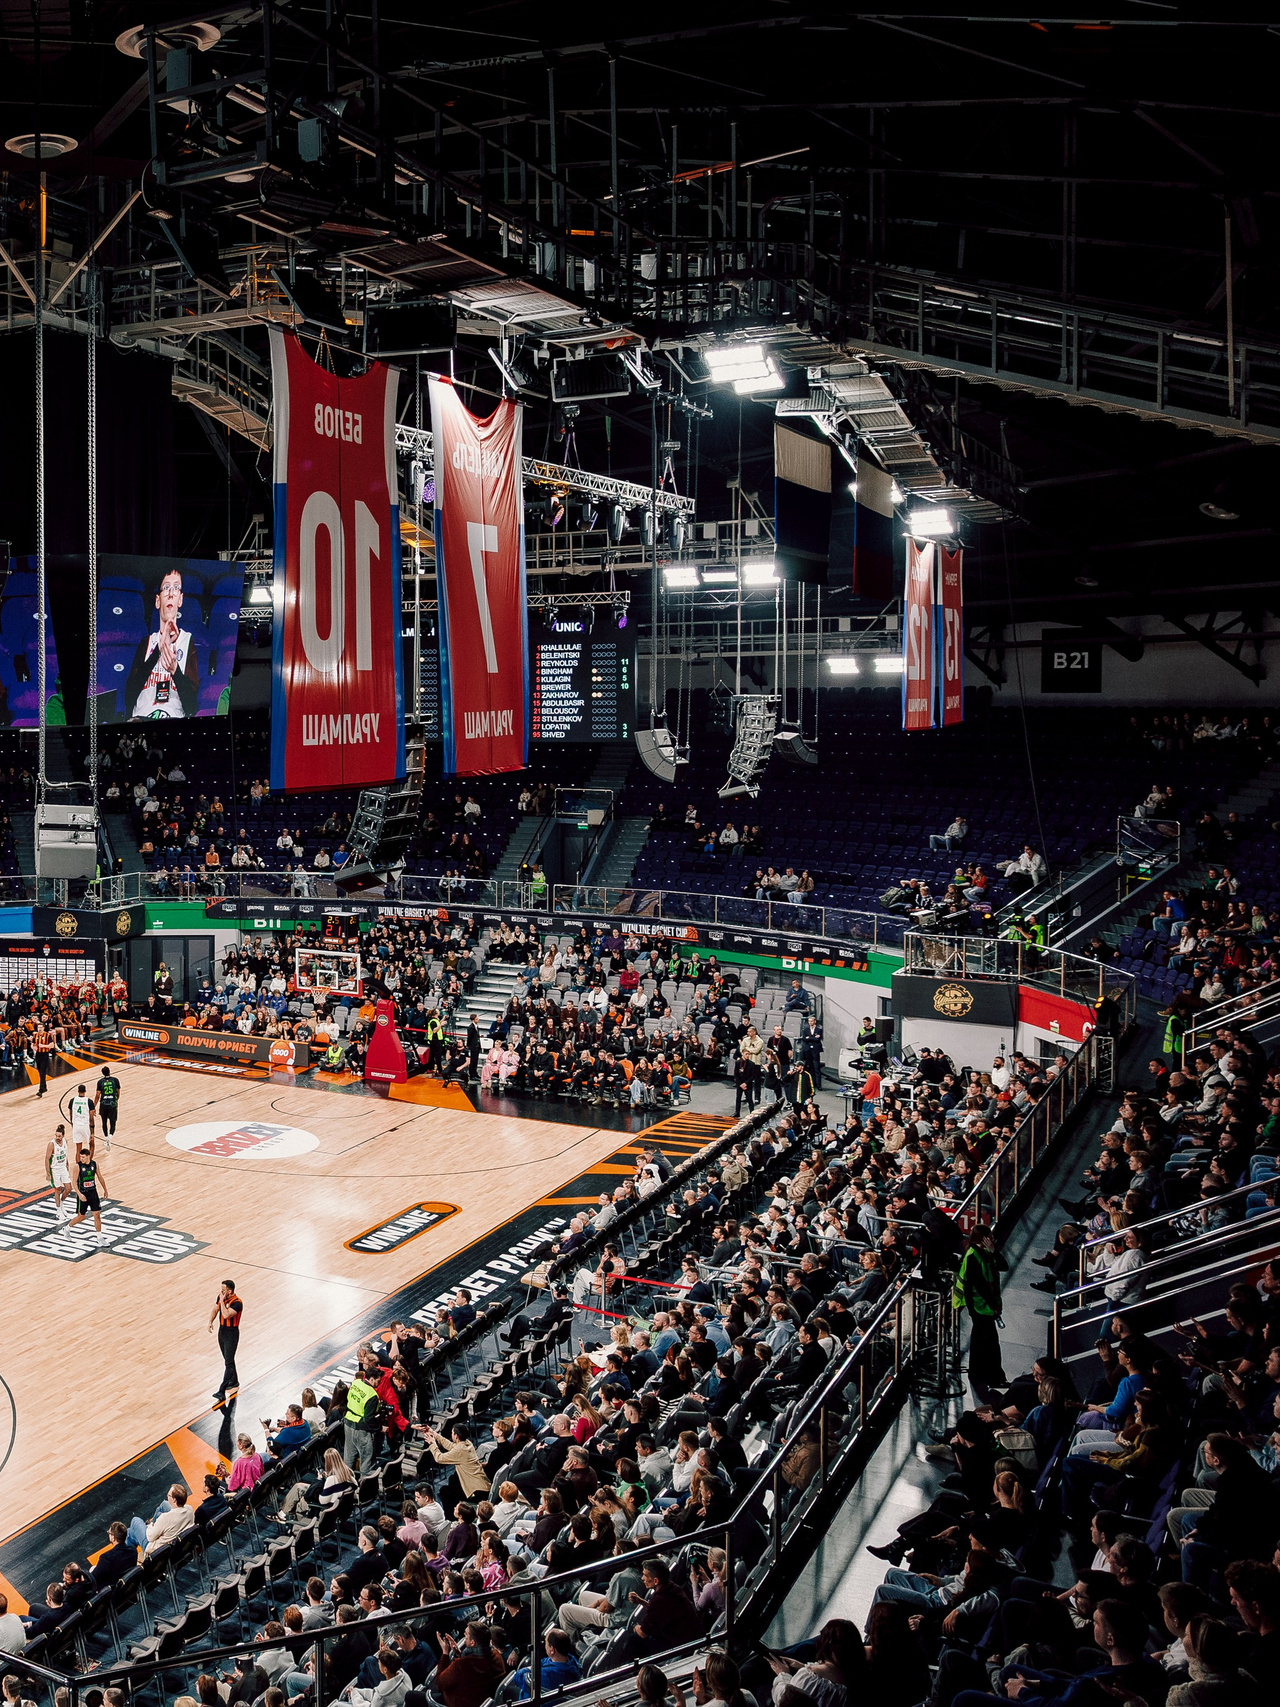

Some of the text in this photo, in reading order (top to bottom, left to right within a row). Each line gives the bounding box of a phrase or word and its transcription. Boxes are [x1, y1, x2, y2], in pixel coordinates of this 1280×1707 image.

[404, 907, 425, 918] BASKET
[326, 925, 341, 936] 21
[621, 923, 650, 934] WINLINE
[676, 927, 688, 938] CUP
[125, 1027, 160, 1042] WINLINE
[177, 1034, 257, 1054] ПОЛУЧИ ФРИБЕТ
[272, 1049, 289, 1058] 3000
[149, 1057, 247, 1075] WINLINE
[104, 1086, 114, 1094] 25
[77, 1106, 82, 1114] 4
[355, 1209, 439, 1251] WINLINE
[112, 1230, 198, 1262] CUP
